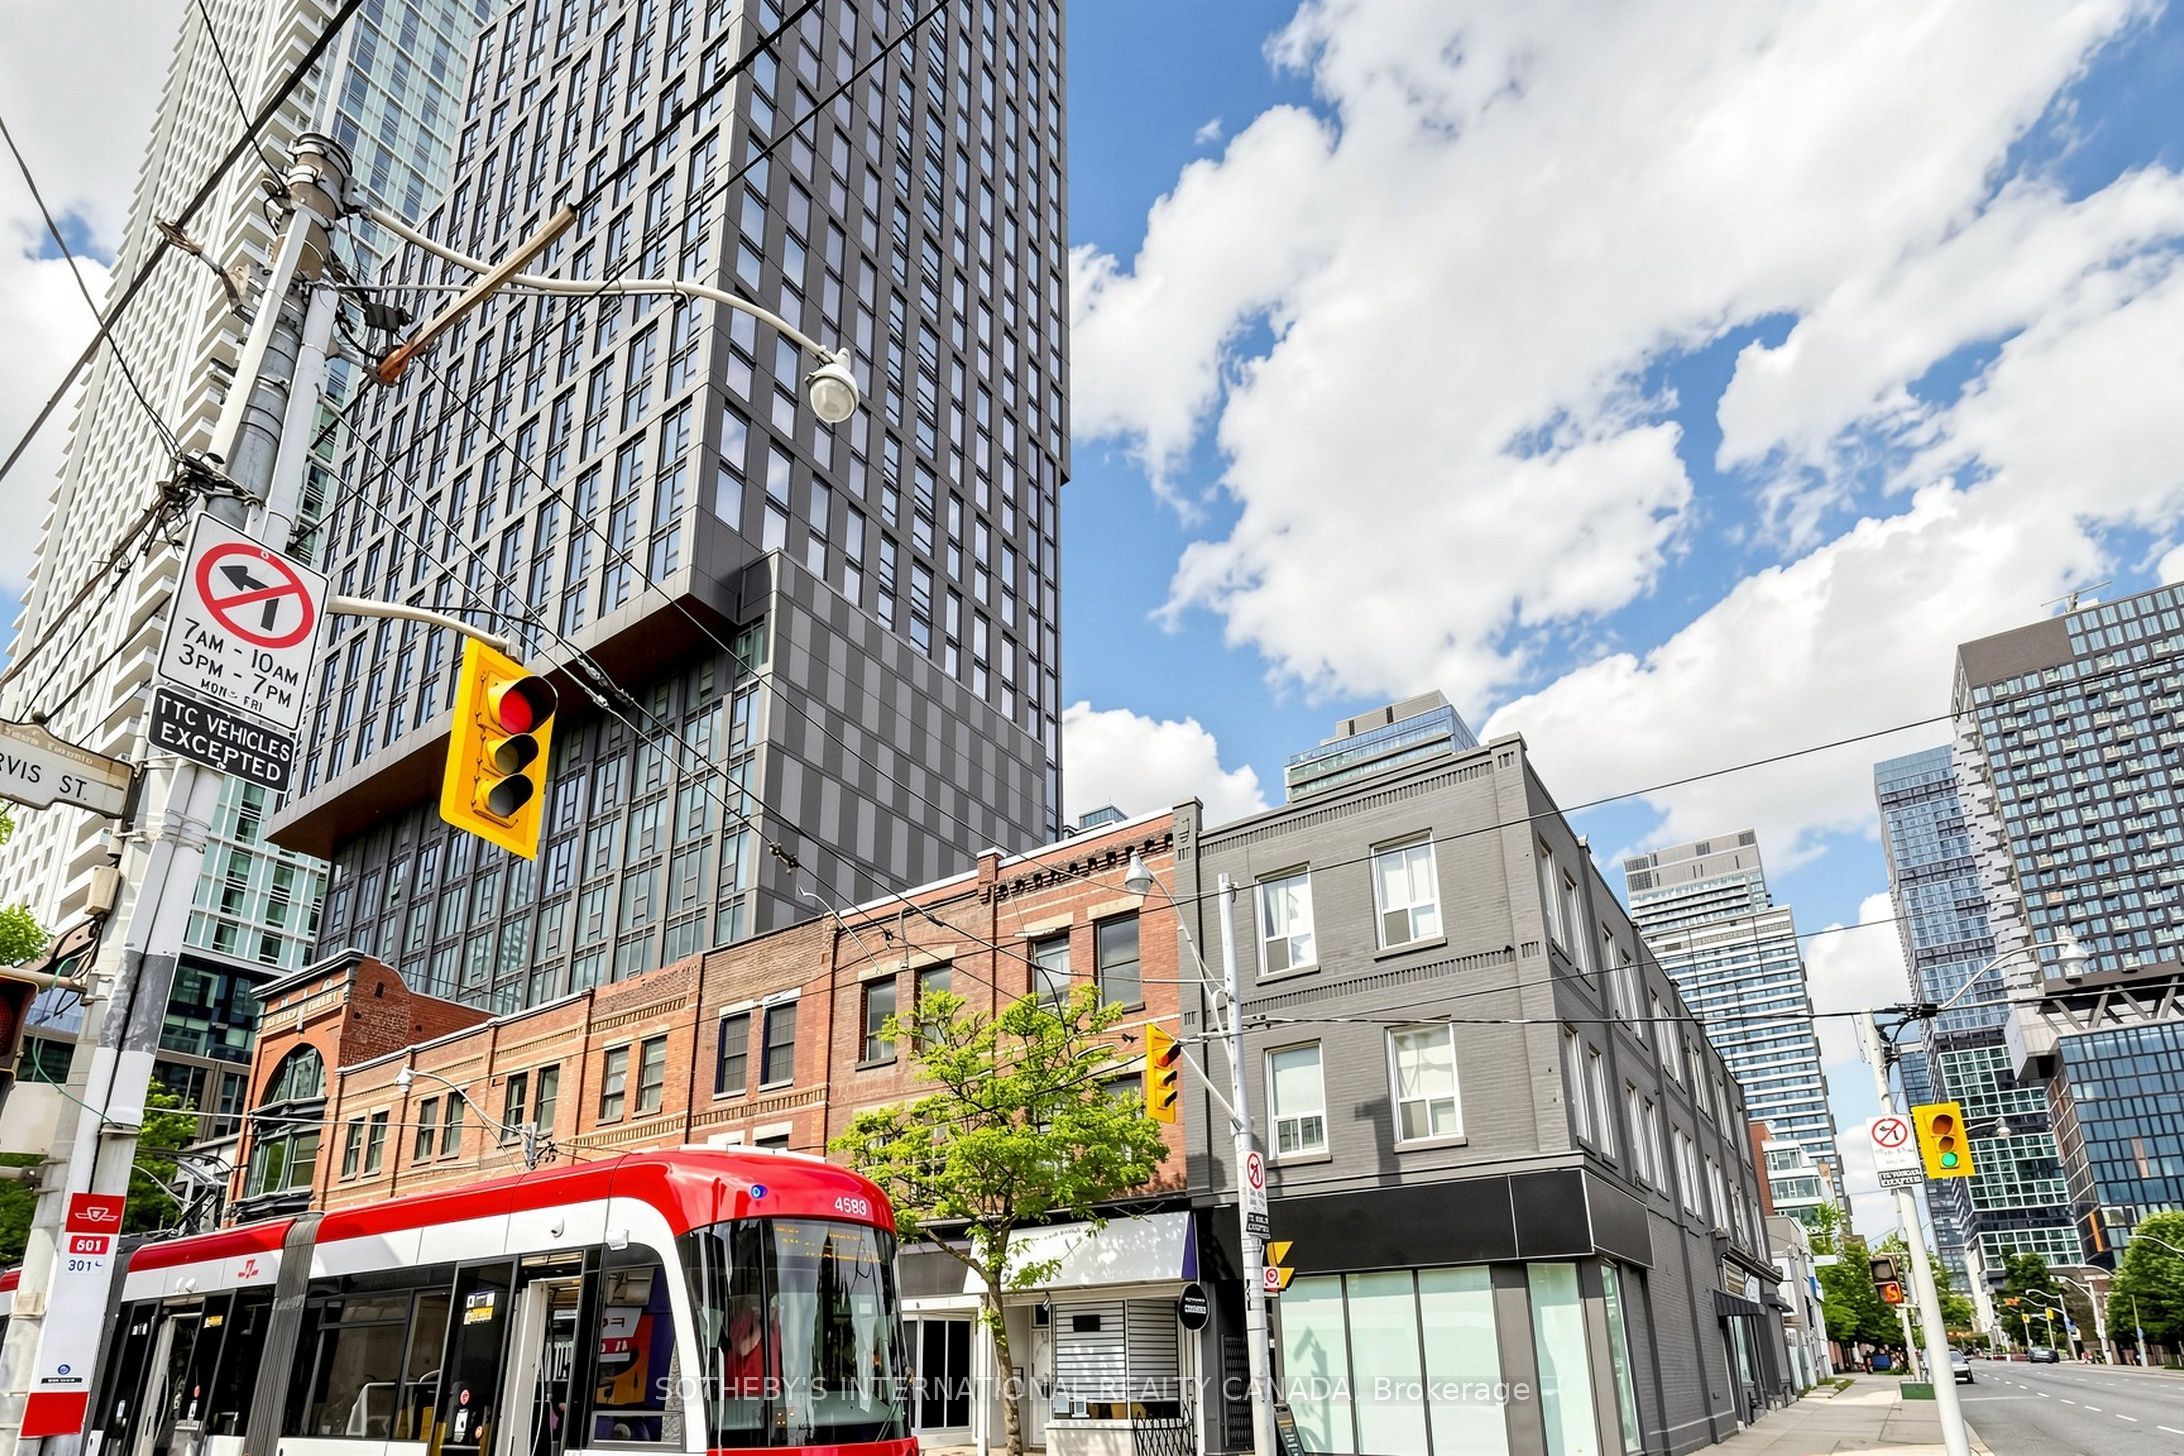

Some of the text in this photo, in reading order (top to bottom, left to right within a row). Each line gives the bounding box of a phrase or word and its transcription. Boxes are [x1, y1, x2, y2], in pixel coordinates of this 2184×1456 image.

[178, 643, 224, 678] 3PM
[252, 672, 292, 708] 7PM
[184, 617, 224, 654] 7AM
[251, 648, 300, 687] 10AM
[159, 694, 291, 763] TTC VEHICLES
[160, 721, 281, 782] EXCEPTED
[67, 1259, 92, 1272] 301
